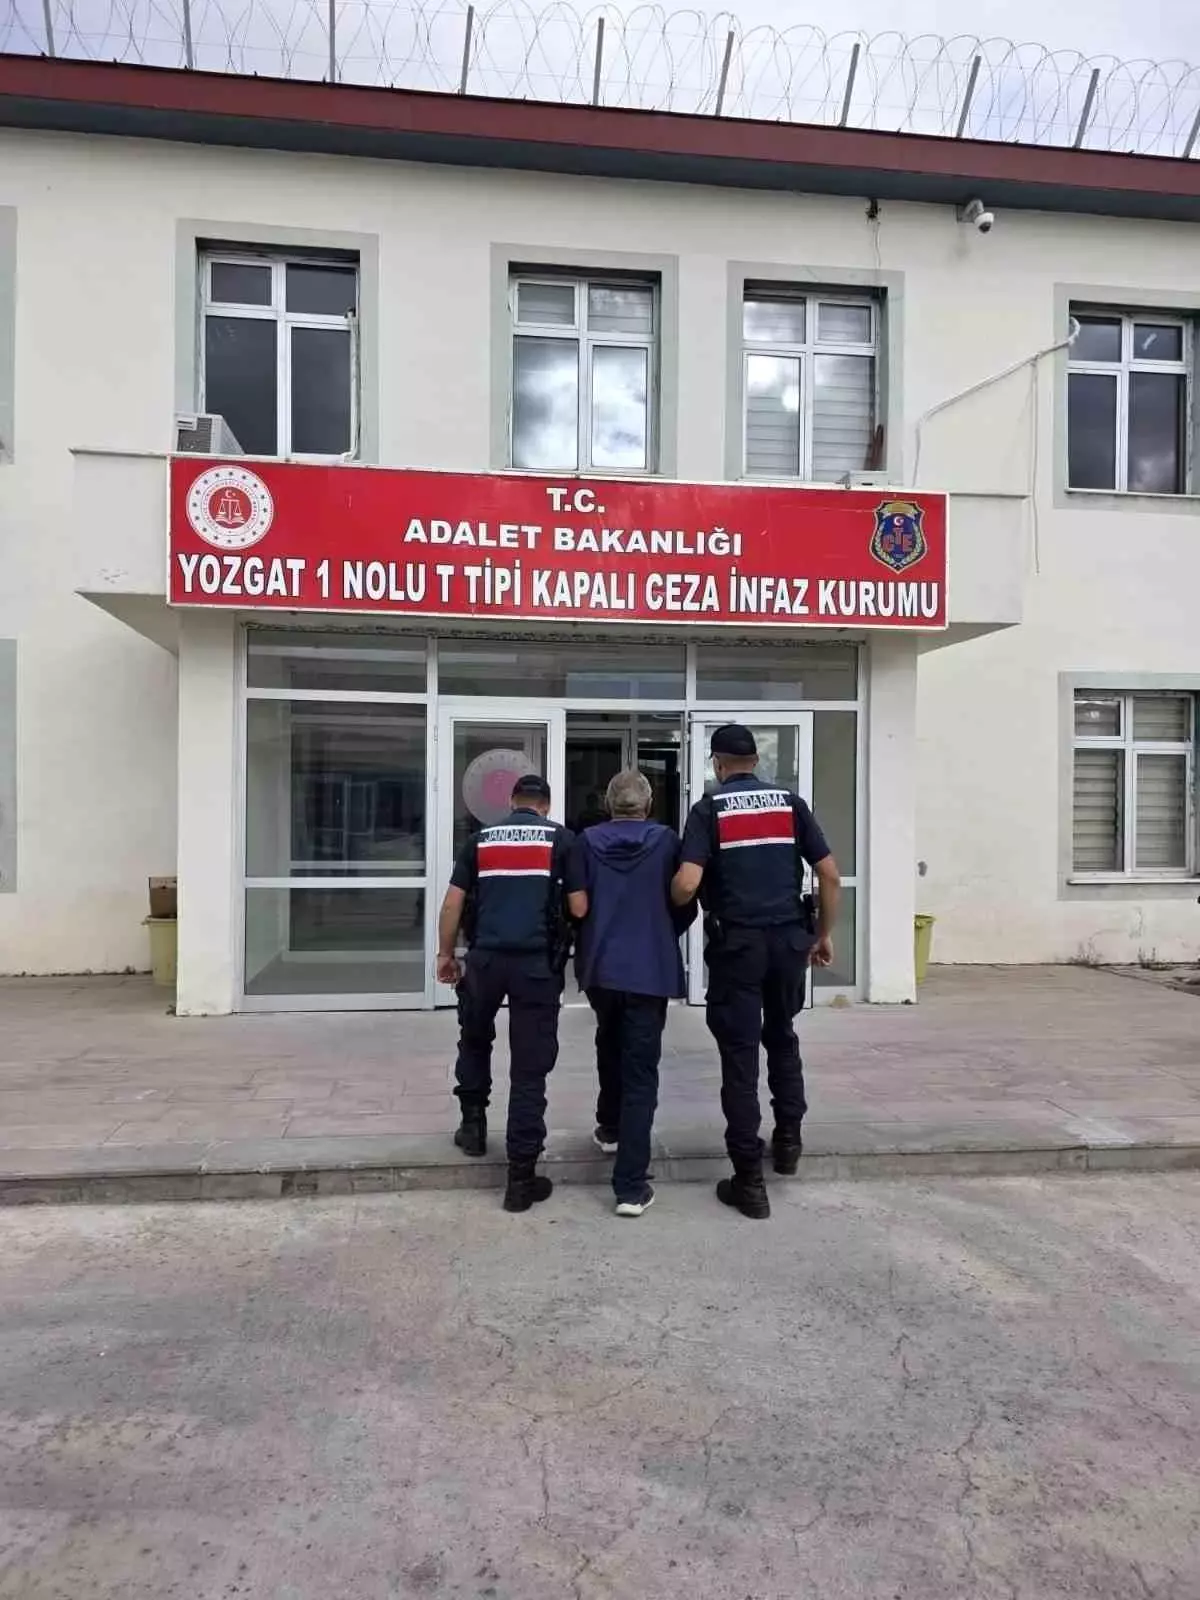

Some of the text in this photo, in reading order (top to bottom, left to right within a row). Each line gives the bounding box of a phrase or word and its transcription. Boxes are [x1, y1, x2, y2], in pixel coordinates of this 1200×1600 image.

[546, 487, 606, 513] T.C.
[403, 519, 742, 557] ADALET BAKANLIĞI
[178, 554, 939, 618] YOZGAT 1 NOLU T TİPİ KAPALI CEZA İNFAZ KURUMU
[723, 793, 787, 811] JANDARMA
[484, 828, 547, 842] JANDARMA
